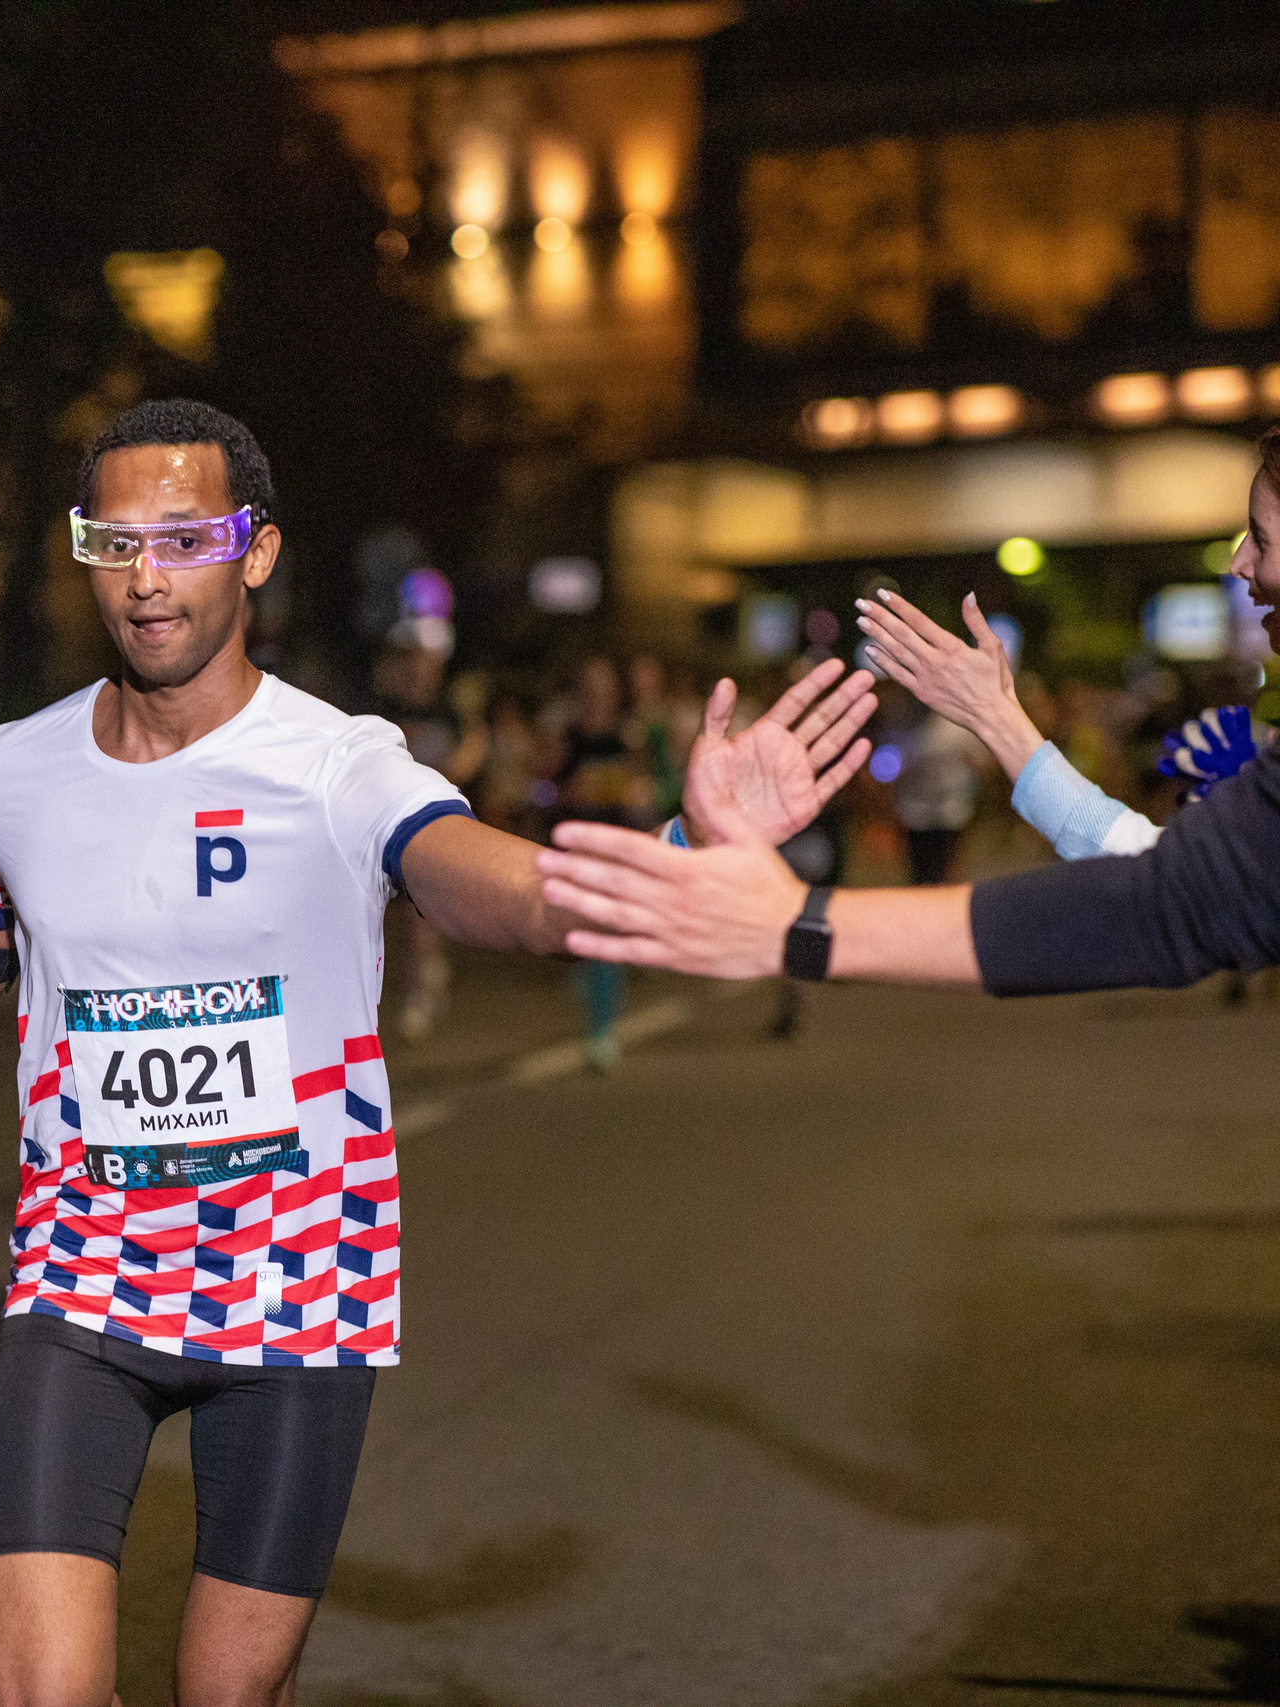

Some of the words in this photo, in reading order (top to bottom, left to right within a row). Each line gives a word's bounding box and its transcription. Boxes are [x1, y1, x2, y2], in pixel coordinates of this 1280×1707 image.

[85, 977, 265, 1022] НОЧНОЙ
[169, 1014, 237, 1029] ЗАБЕГ
[101, 1040, 256, 1109] 4021
[140, 1109, 229, 1132] МИХАИЛ
[244, 1155, 262, 1165] СПОРТ
